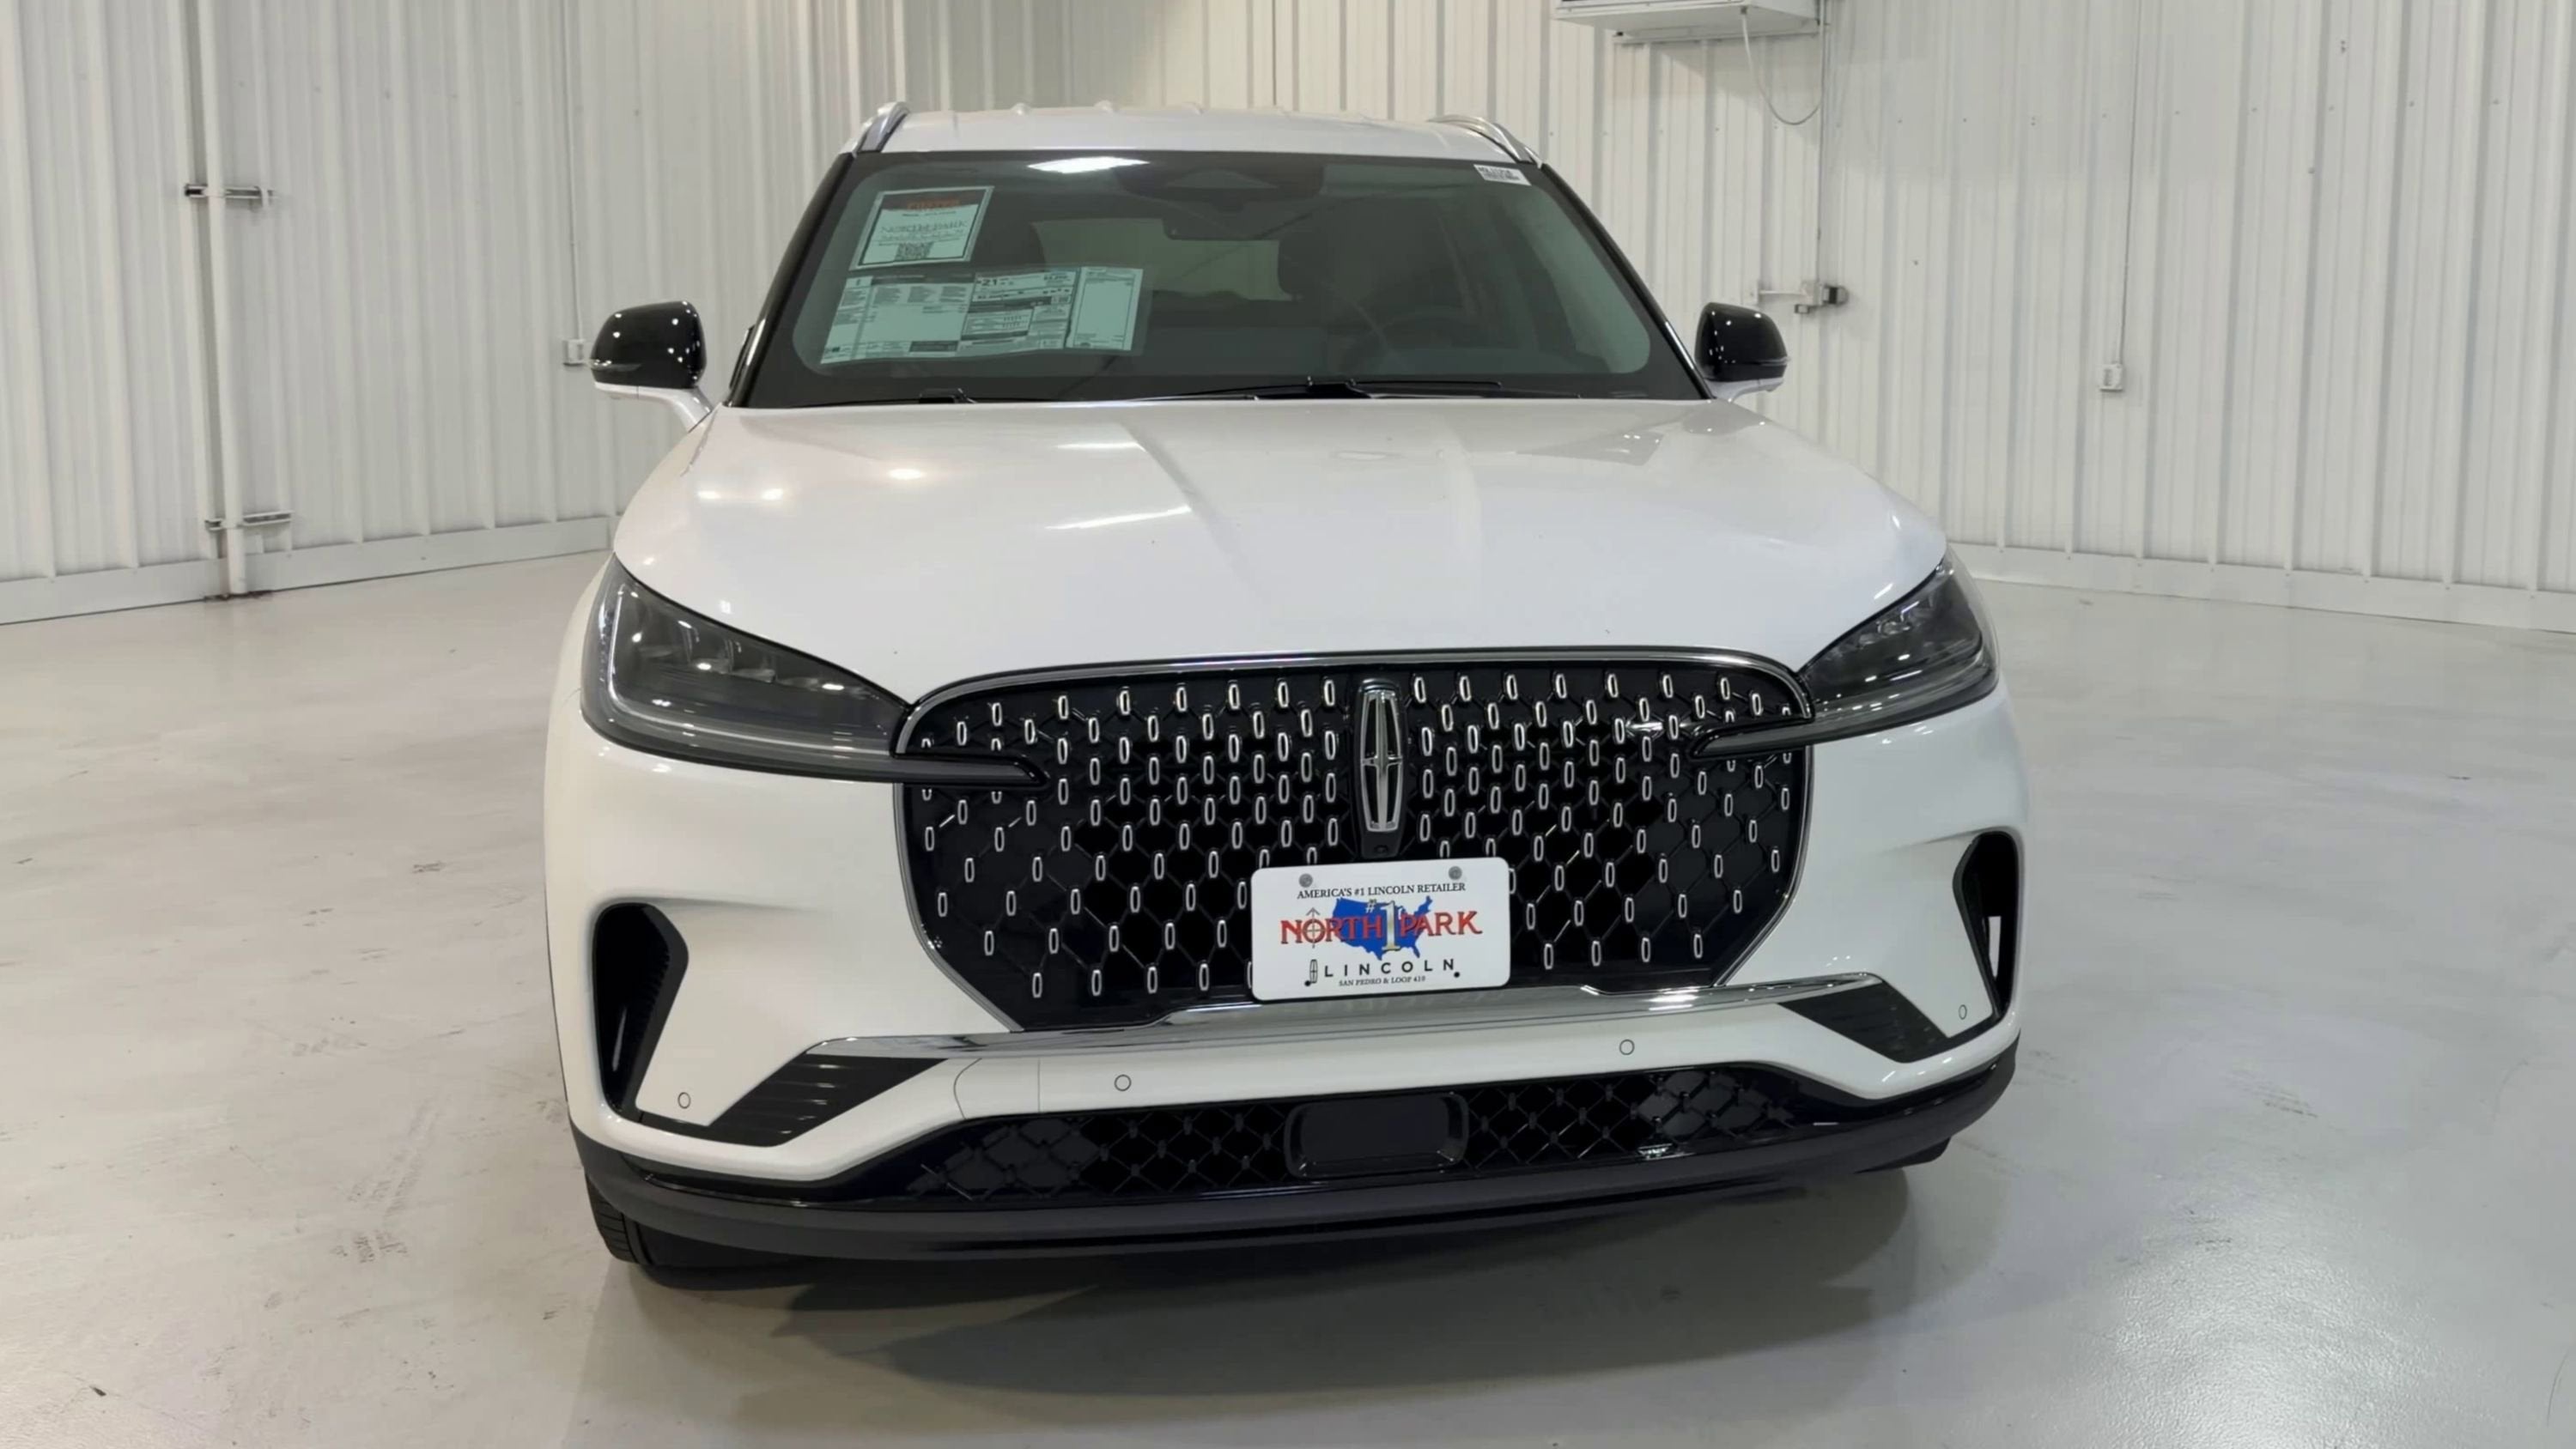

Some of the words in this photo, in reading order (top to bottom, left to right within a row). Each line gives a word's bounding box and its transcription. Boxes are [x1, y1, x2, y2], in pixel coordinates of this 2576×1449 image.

[1297, 887, 1352, 900] AMERICA'S
[1354, 887, 1365, 896] #1
[1368, 885, 1415, 896] LINCOLN
[1417, 882, 1466, 894] RETAILER
[1280, 915, 1382, 944] NORTH
[1400, 910, 1483, 938] PARK
[1325, 958, 1455, 978] LINCOLN
